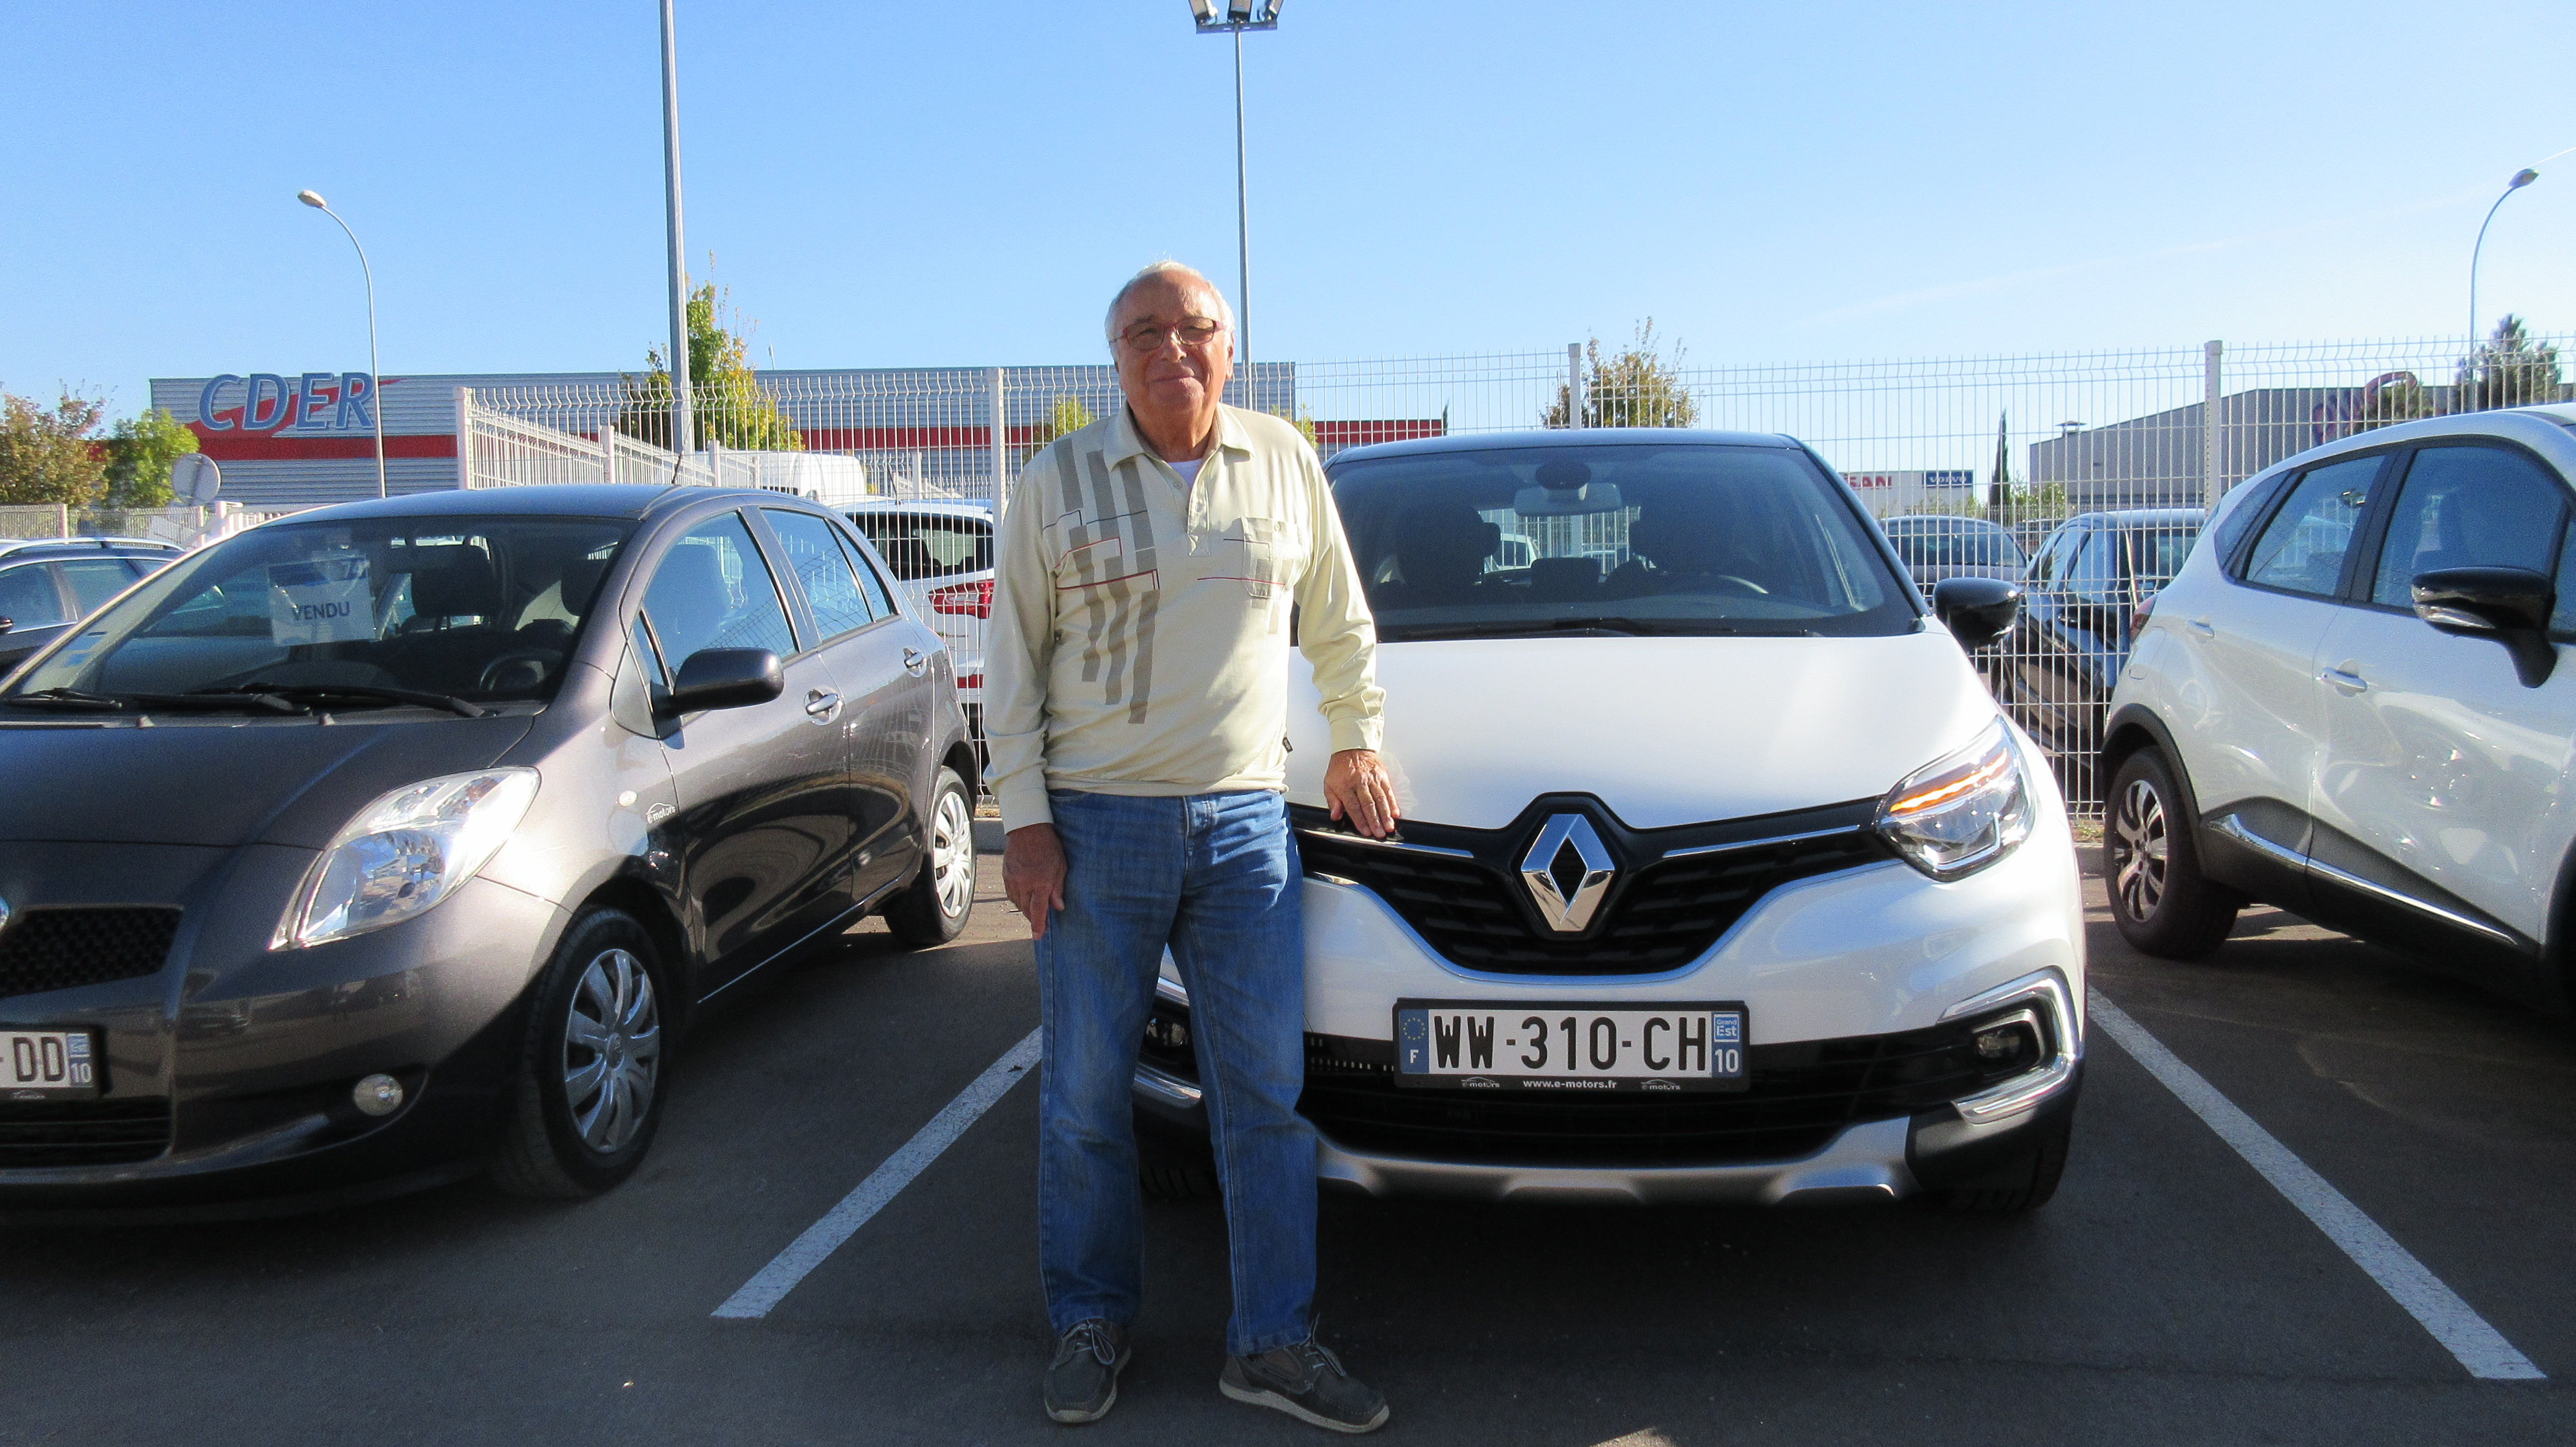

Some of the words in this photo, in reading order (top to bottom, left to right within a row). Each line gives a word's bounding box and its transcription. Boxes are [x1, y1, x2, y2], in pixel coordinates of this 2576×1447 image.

[199, 373, 374, 431] CDER
[292, 601, 350, 620] VENDU
[1716, 1025, 1737, 1036] Est
[1434, 1016, 1706, 1070] WW-310-CH
[1410, 1049, 1419, 1063] F
[1715, 1049, 1739, 1072] 10
[71, 1063, 92, 1083] 10
